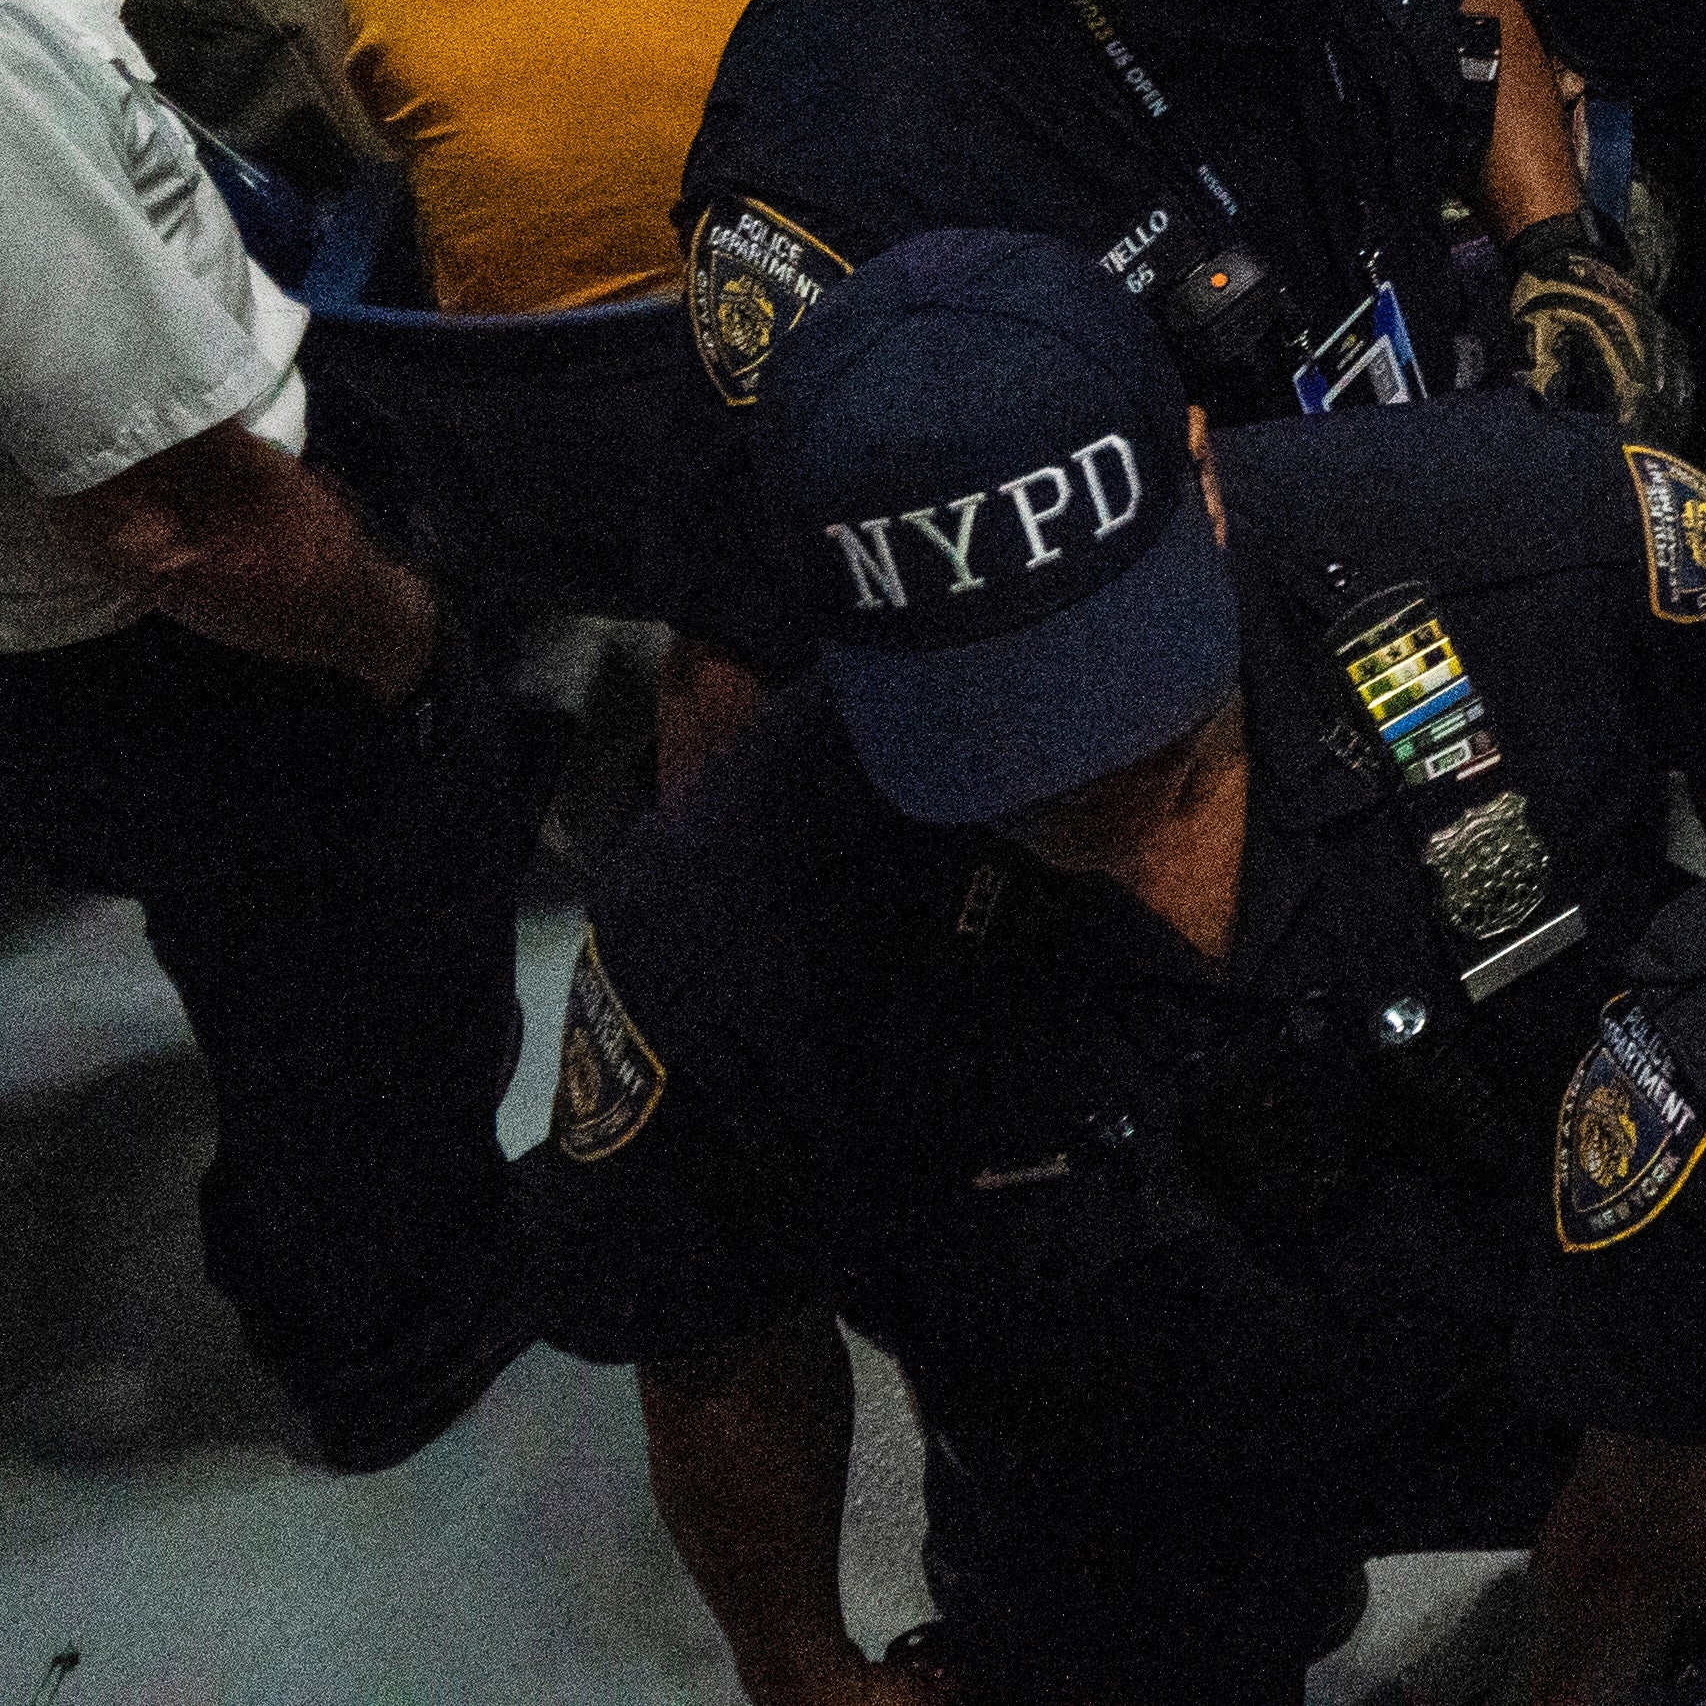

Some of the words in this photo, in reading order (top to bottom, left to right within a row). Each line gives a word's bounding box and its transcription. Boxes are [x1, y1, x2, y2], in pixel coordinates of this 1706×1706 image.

[1104, 39, 1136, 69] US
[1124, 65, 1170, 119] OPEN
[737, 213, 804, 266] POLICE
[1125, 261, 1157, 295] 65
[824, 433, 1143, 610] NYPD
